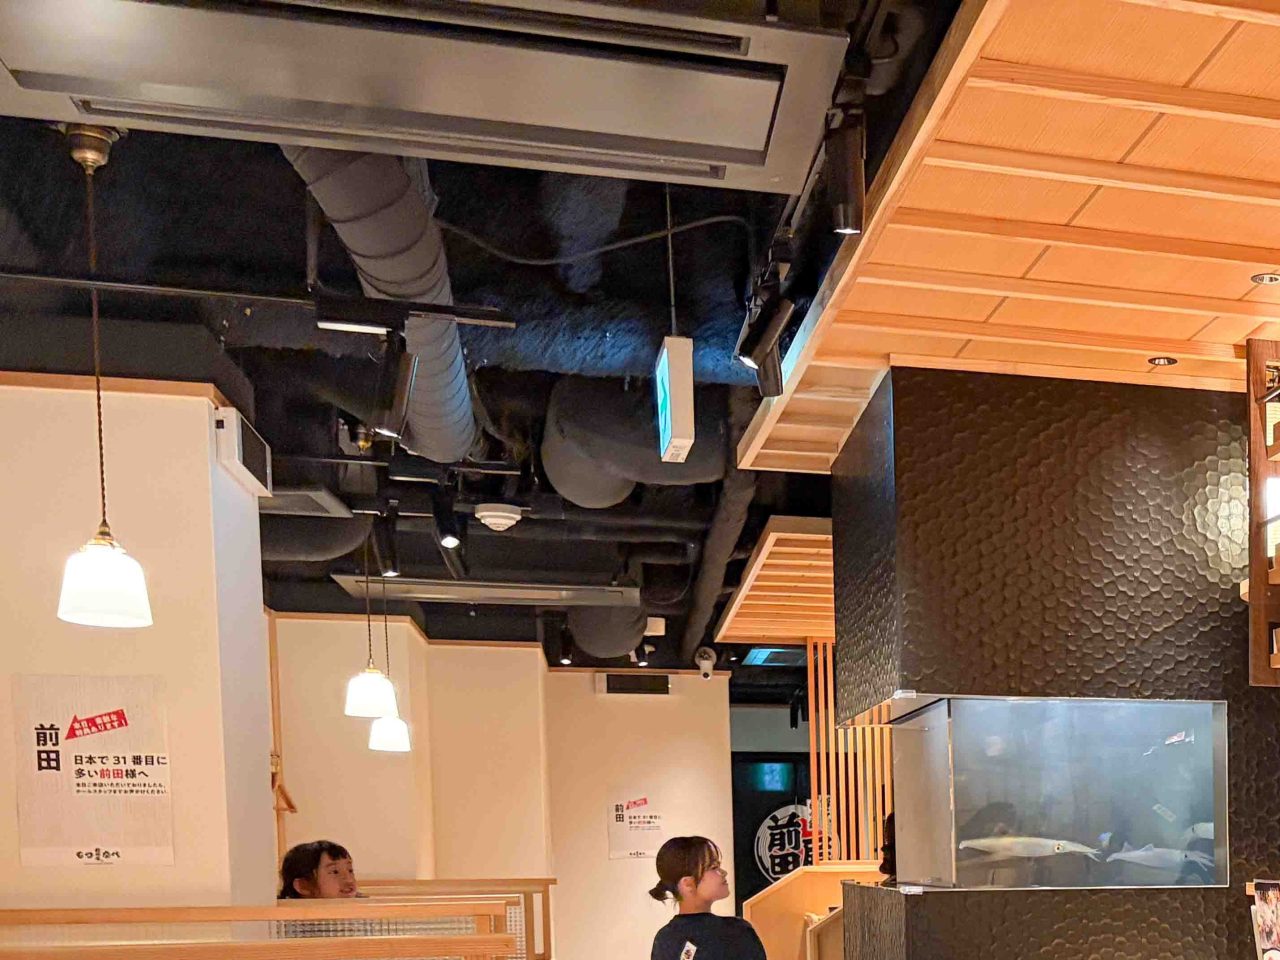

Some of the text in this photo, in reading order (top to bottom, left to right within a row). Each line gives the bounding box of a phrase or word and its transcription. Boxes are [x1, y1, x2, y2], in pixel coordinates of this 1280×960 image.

[35, 723, 61, 771] 前田
[75, 768, 149, 779] 多い前田様へ
